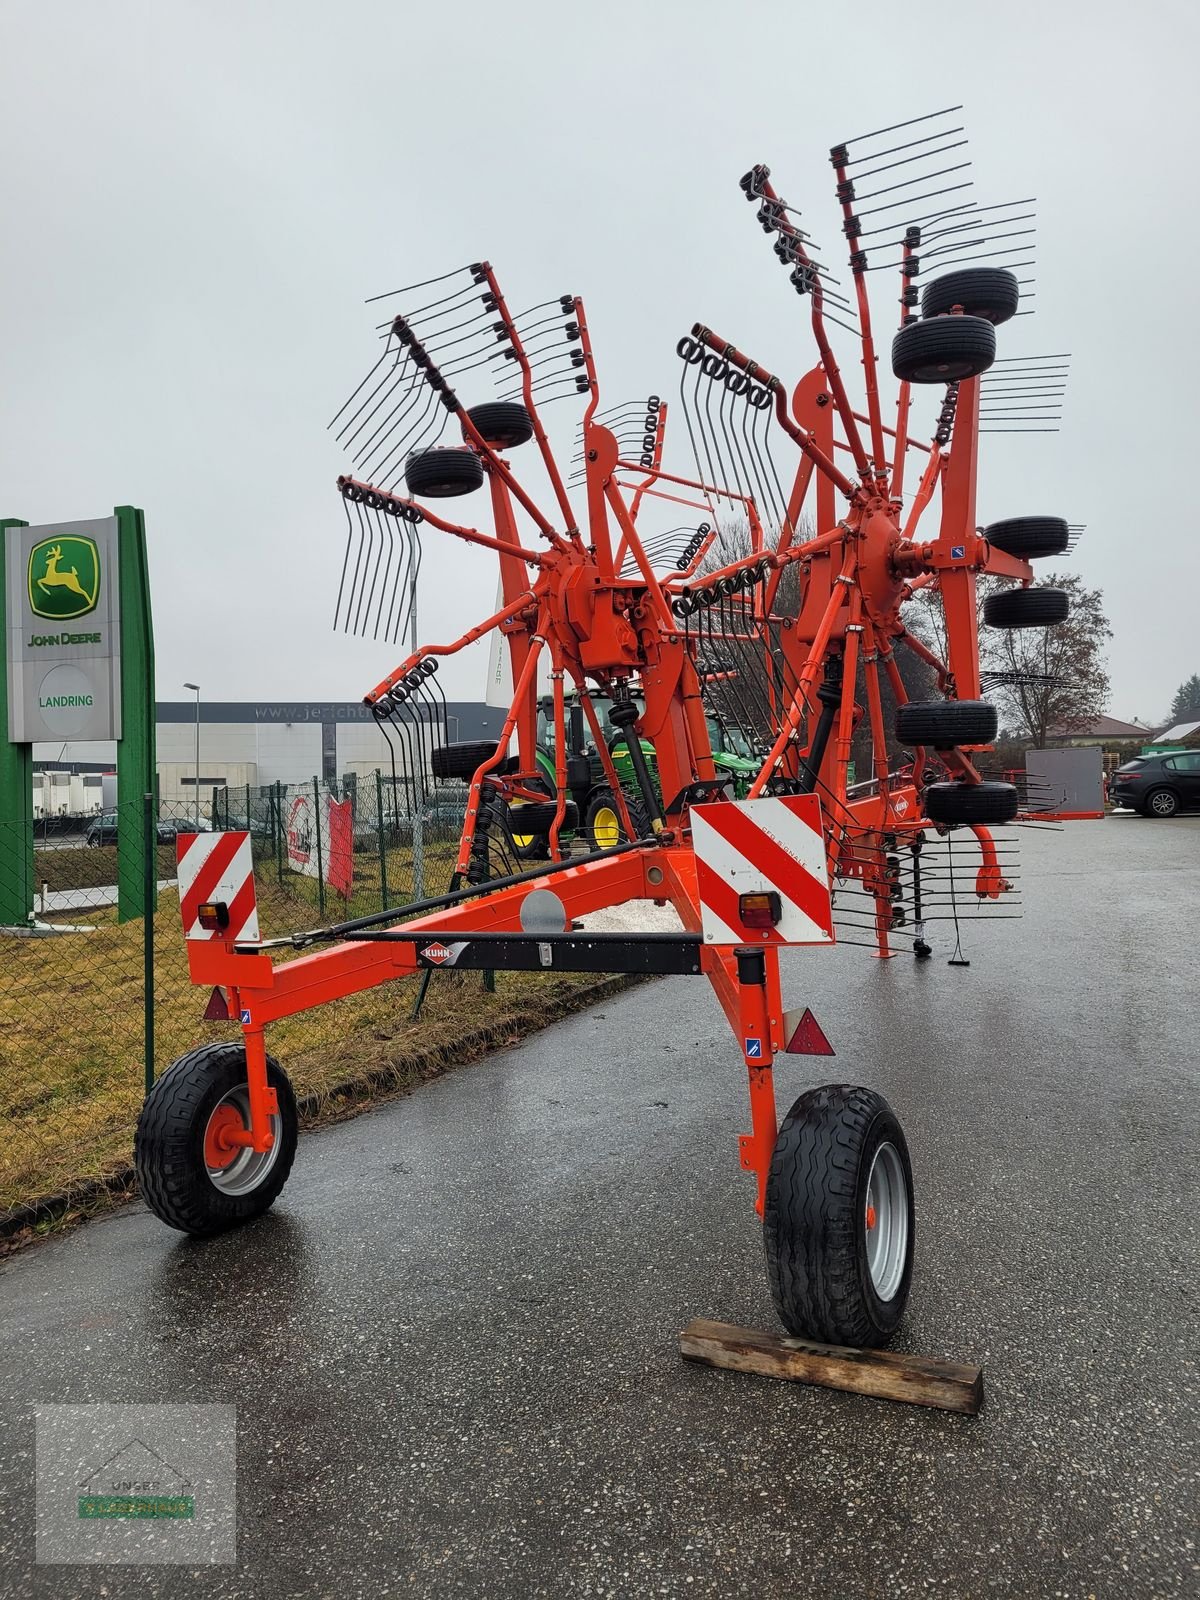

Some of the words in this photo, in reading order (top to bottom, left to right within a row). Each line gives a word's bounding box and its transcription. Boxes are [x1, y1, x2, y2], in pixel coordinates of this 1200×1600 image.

[27, 634, 60, 648] JOHN
[60, 632, 102, 645] DEERE
[39, 695, 93, 708] LANDRING
[425, 949, 450, 957] KUHN
